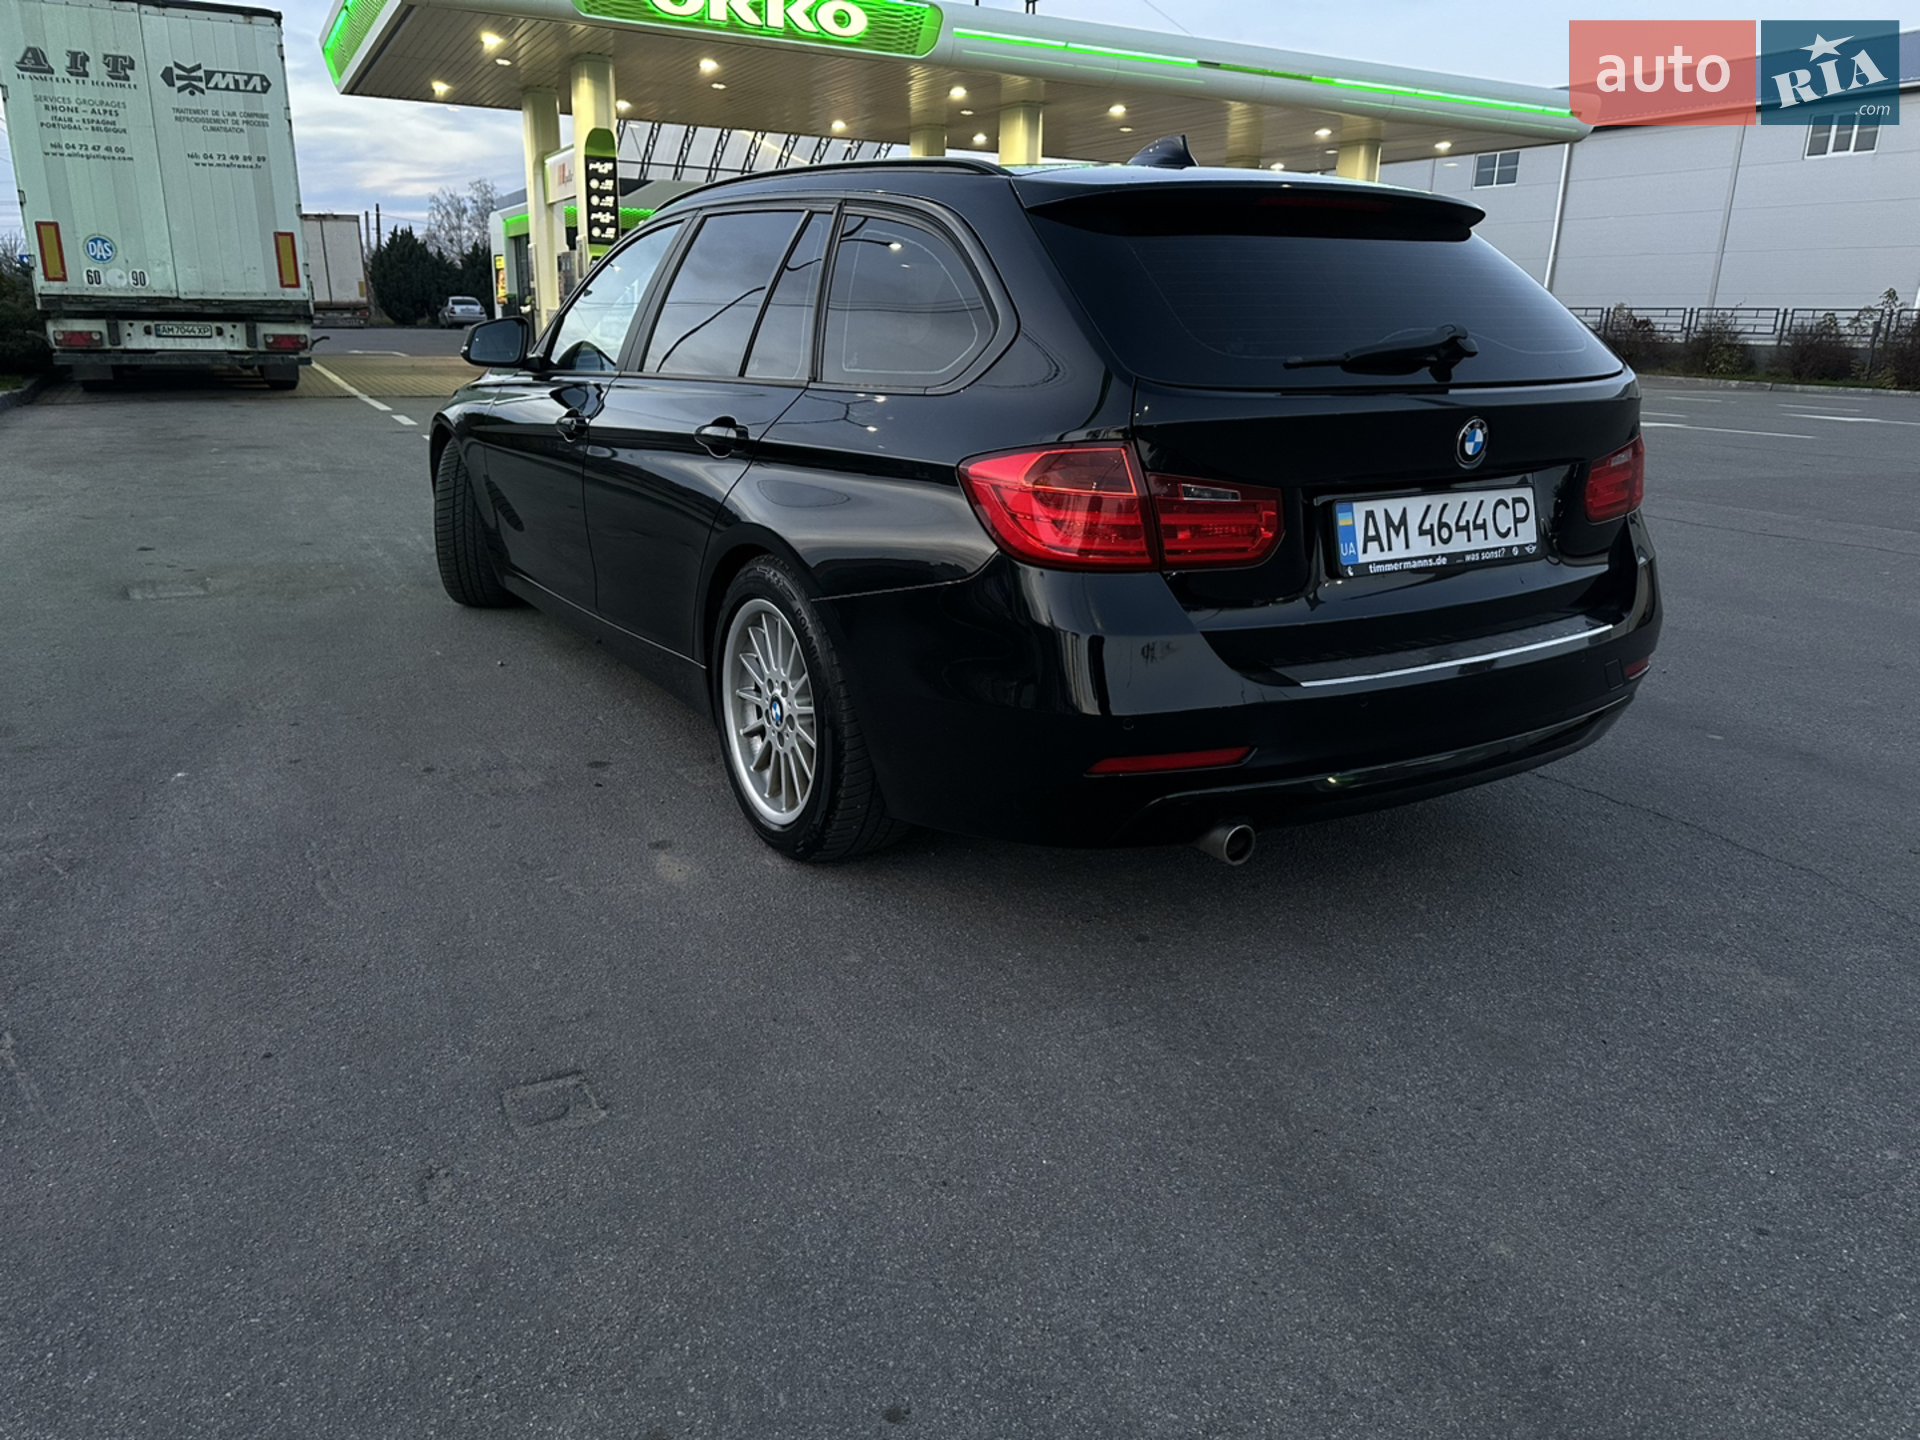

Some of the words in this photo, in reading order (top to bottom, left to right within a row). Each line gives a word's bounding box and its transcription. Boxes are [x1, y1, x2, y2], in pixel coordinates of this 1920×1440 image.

[14, 46, 136, 82] AIT
[206, 72, 262, 92] MTA
[33, 94, 72, 105] SERVICES
[75, 97, 127, 109] GROUPAGES
[44, 104, 80, 114] RHONE
[90, 108, 119, 117] ALPES
[211, 109, 220, 117] DE
[50, 115, 74, 123] ITALIE
[82, 117, 117, 126] ESPAGNE
[231, 118, 240, 126] DE
[242, 119, 270, 128] PROCESS
[40, 121, 82, 131] PORTUGAL
[91, 125, 128, 135] BELGIQUE
[64, 142, 76, 150] 04
[79, 143, 89, 151] 72
[114, 146, 126, 154] 00
[216, 153, 227, 161] 72
[88, 239, 113, 259] DAS
[86, 268, 102, 286] 60
[131, 270, 147, 287] 90
[1340, 541, 1357, 557] UA
[1368, 555, 1448, 575] timmermanns.de
[1465, 551, 1480, 563] was
[1481, 547, 1507, 560] sonst?
